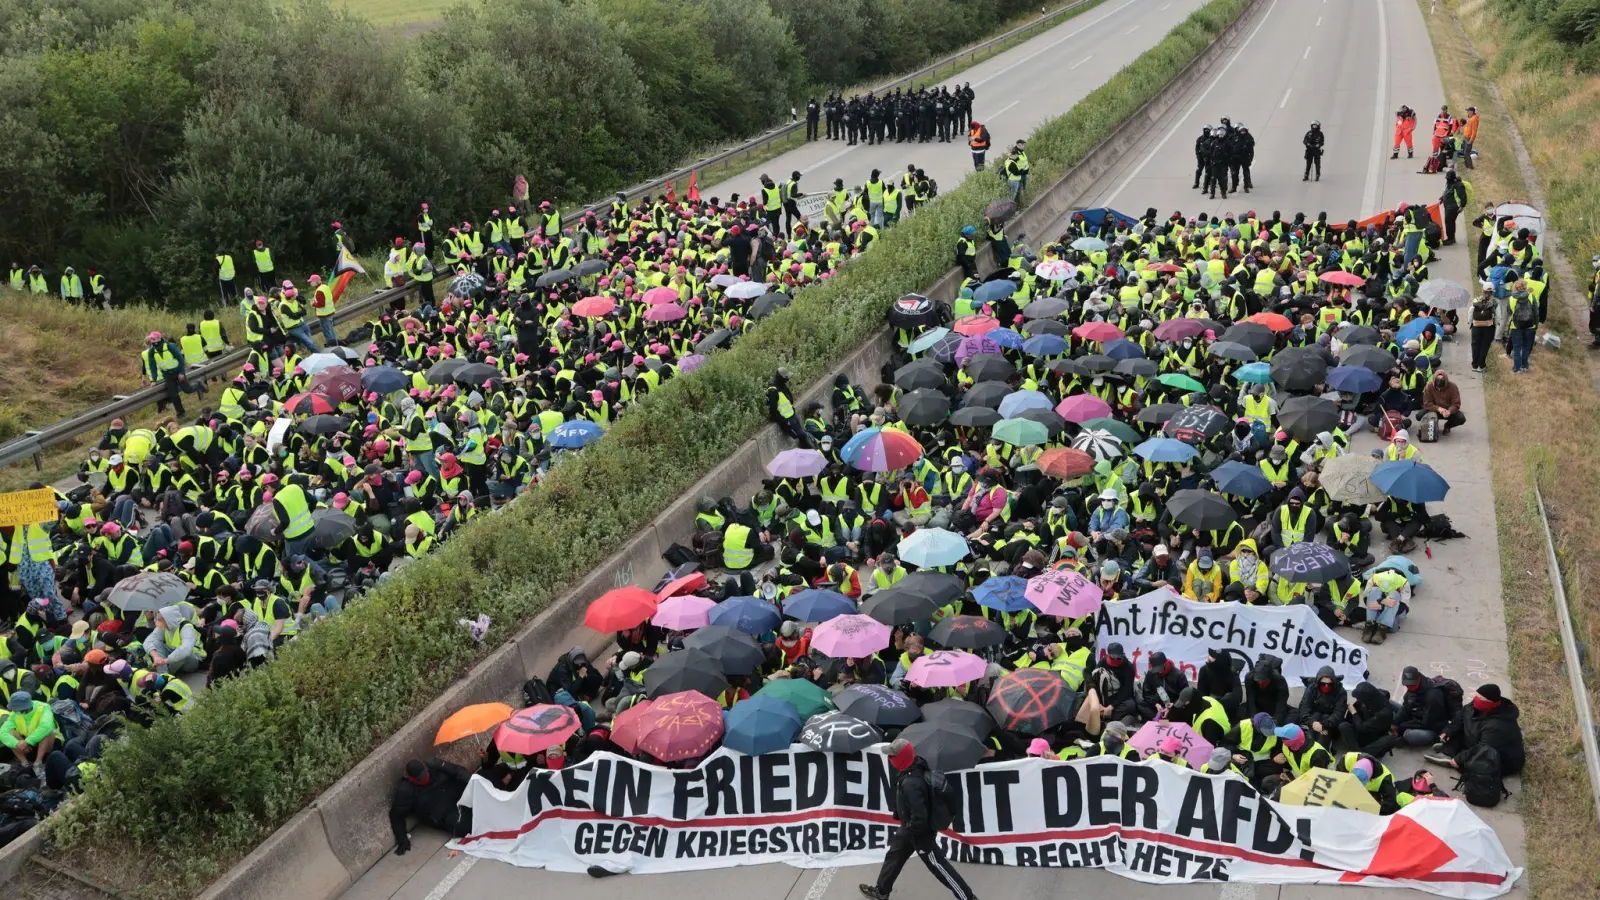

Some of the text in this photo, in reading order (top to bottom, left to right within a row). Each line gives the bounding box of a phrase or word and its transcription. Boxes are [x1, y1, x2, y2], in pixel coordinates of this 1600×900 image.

[1335, 473, 1369, 494] 161
[613, 560, 635, 588] 161
[1274, 552, 1336, 574] ALERTA
[1155, 724, 1193, 747] FICK
[526, 758, 653, 818] KEIN
[672, 751, 897, 820] FRIEDEN
[1041, 763, 1160, 830] DER
[1175, 775, 1315, 861] AFD!
[574, 821, 670, 859] GEGEN
[1129, 842, 1234, 881] HETZE
